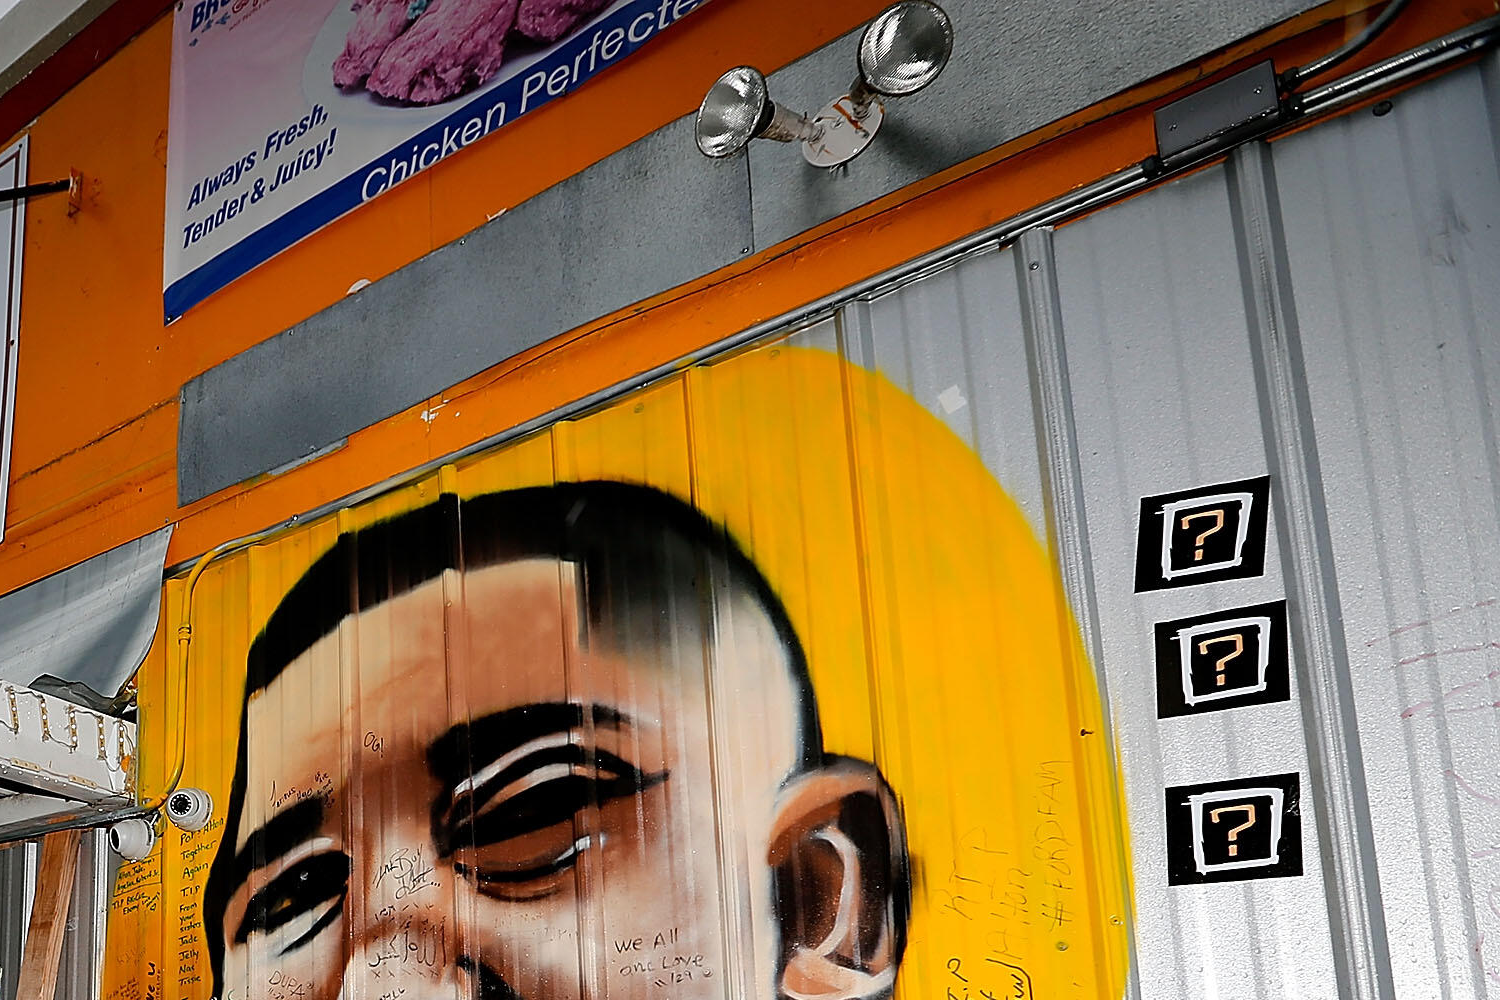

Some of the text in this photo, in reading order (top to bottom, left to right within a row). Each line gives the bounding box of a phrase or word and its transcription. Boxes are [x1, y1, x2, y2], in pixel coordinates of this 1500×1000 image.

[187, 103, 329, 211] Always Fresh,
[361, 98, 506, 202] Chicken
[181, 127, 337, 250] Tender & Juicy!
[180, 839, 218, 862] Together
[182, 862, 209, 881] Again
[179, 902, 198, 914] From
[653, 927, 679, 946] All
